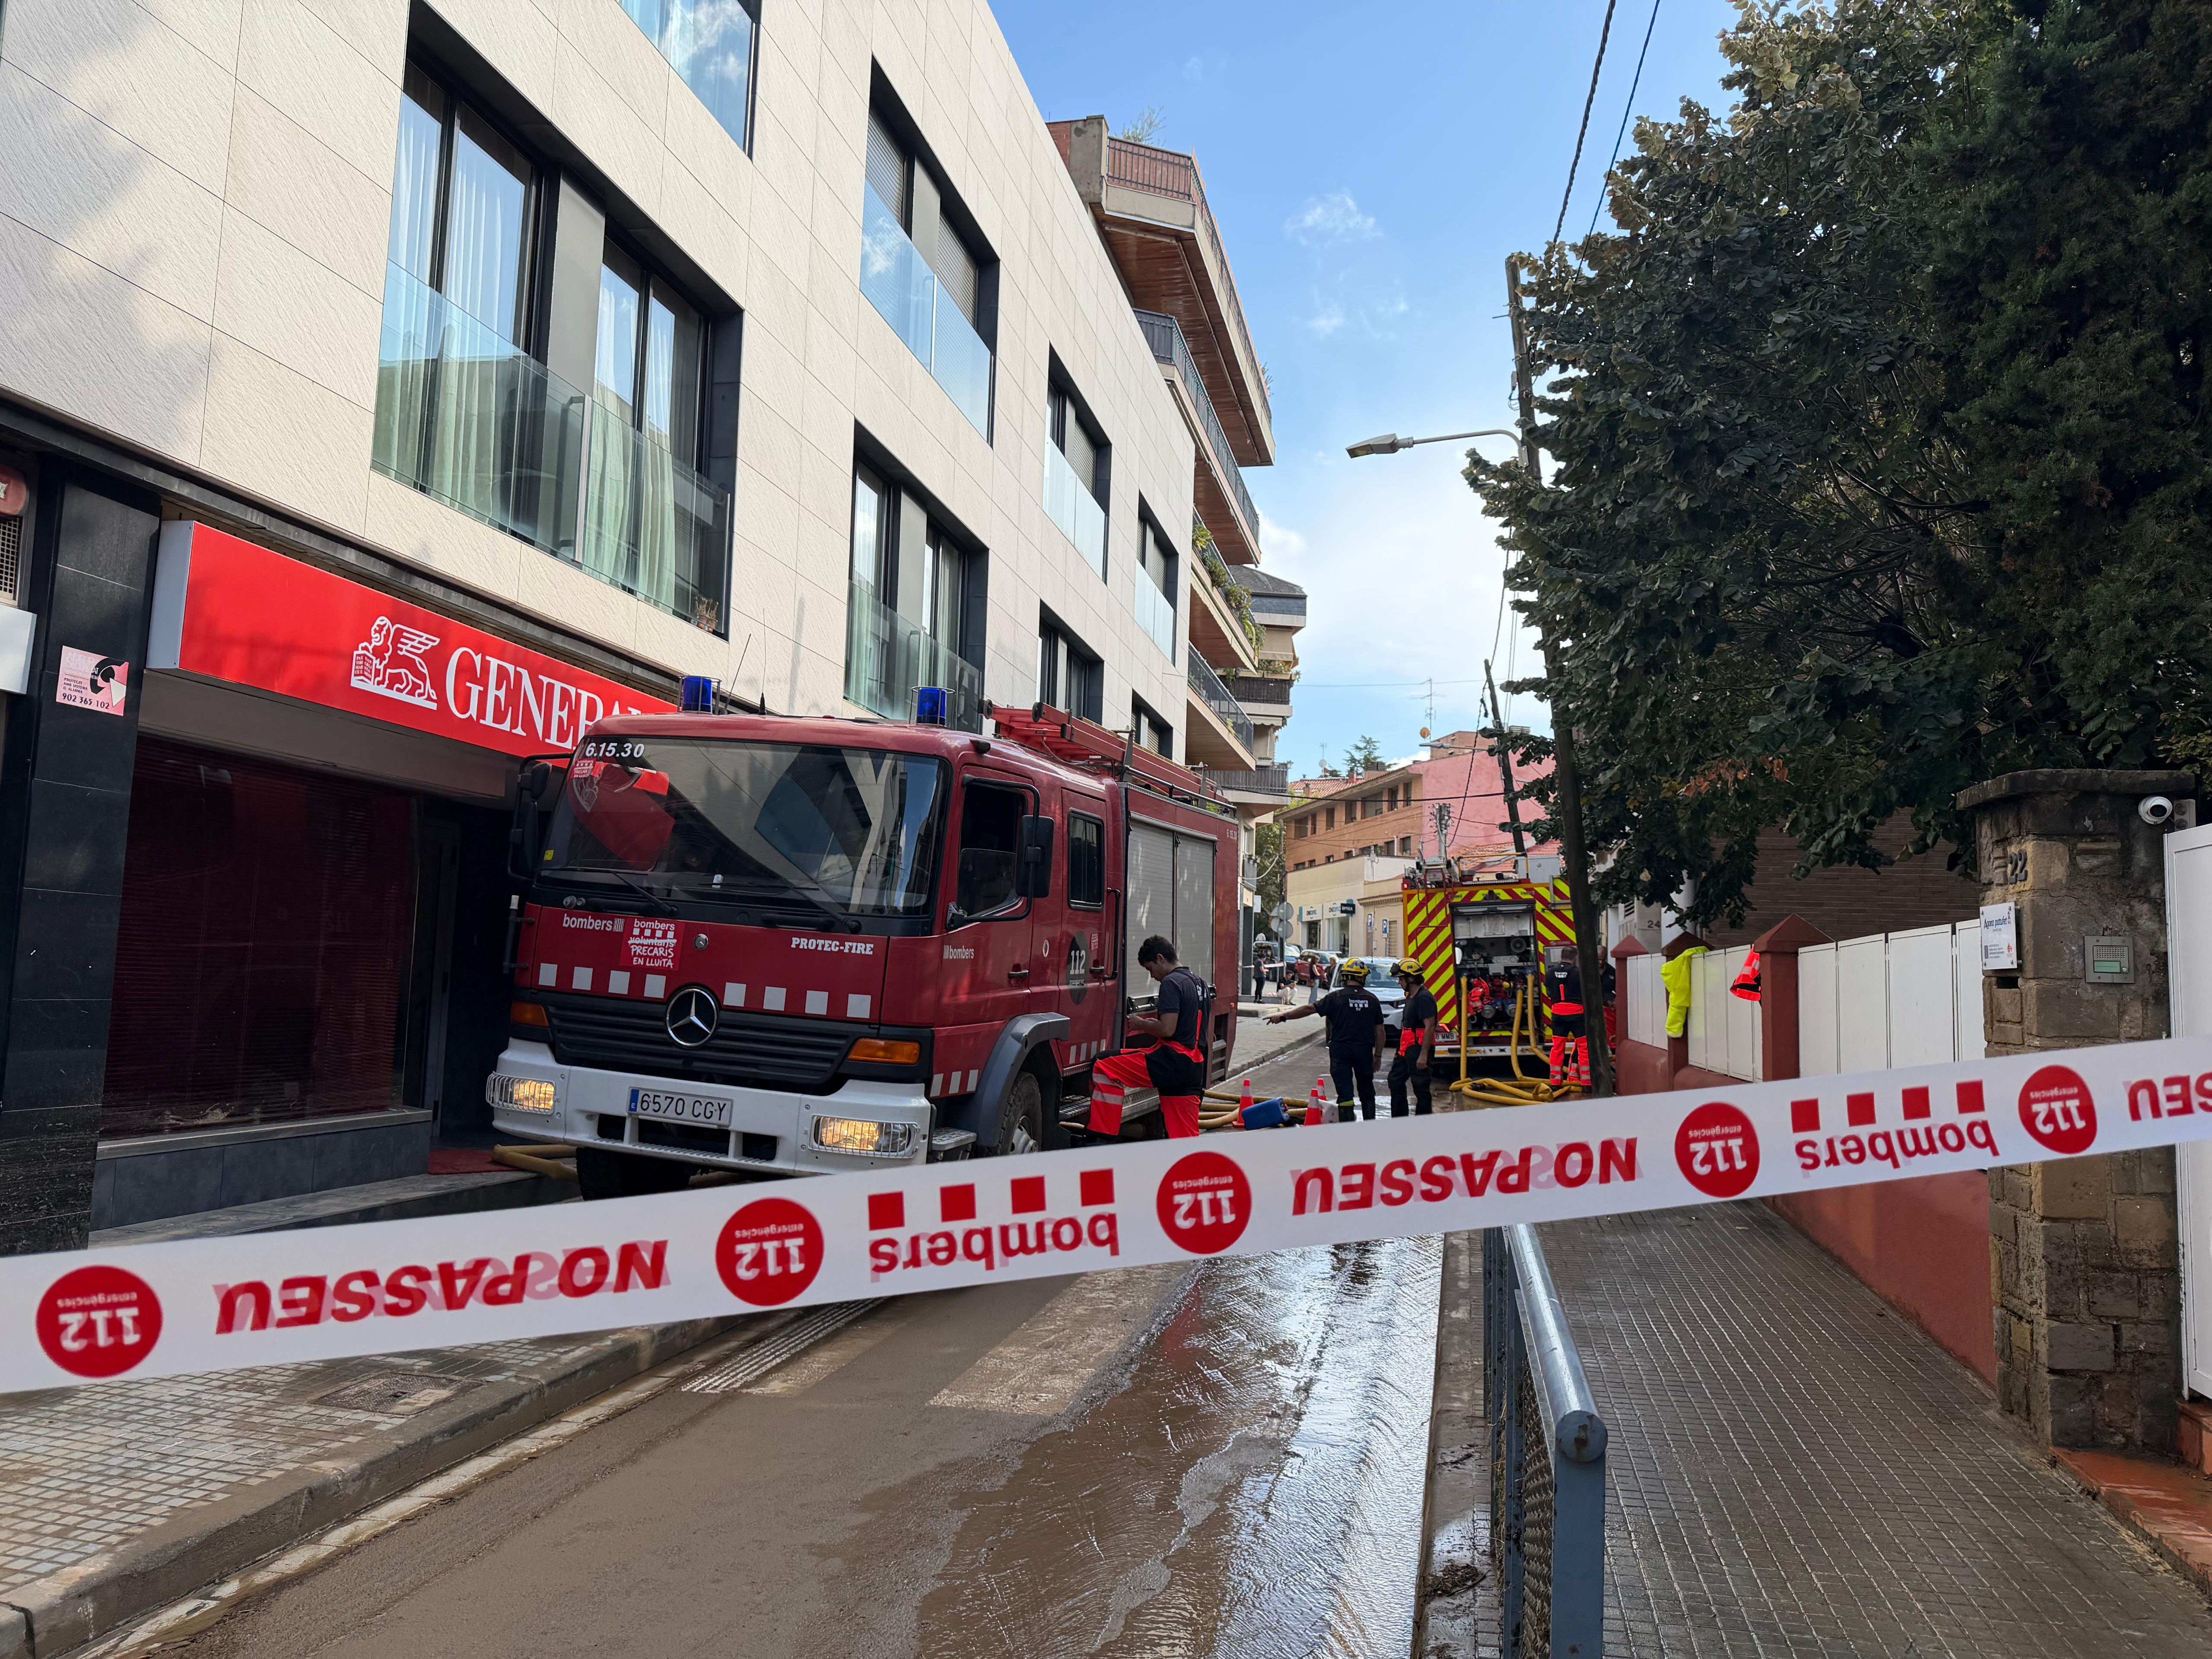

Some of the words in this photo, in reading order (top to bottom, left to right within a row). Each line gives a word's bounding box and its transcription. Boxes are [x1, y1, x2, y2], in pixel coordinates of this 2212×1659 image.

[62, 693, 77, 702] 902
[79, 696, 93, 706] 365
[96, 700, 110, 709] 102
[446, 646, 641, 750] GENER
[585, 742, 645, 758] 6.15.30
[2007, 849, 2028, 884] 22
[563, 913, 613, 931] bombers
[634, 918, 675, 930] bombers
[791, 937, 874, 955] PROTEC-FIRE
[949, 945, 974, 959] bombers
[633, 957, 644, 966] EN
[1070, 950, 1086, 975] 112
[640, 1093, 685, 1116] 6570
[692, 1100, 727, 1121] CGY
[2030, 1087, 2078, 1100] emergències
[2031, 1099, 2086, 1135] 112
[1688, 1125, 1742, 1139] emergències
[1795, 1120, 2000, 1170] bombers
[1554, 1137, 1637, 1188] NO
[1689, 1138, 1747, 1176] 112
[1173, 1175, 1233, 1190] emergències
[1292, 1150, 1532, 1216] PASSEU
[1173, 1189, 1236, 1230] 112
[734, 1223, 804, 1239] emergències
[869, 1212, 1119, 1273] bombers
[557, 1240, 668, 1298] NO
[735, 1237, 805, 1281] 112
[57, 1292, 137, 1309] emergències
[216, 1253, 532, 1334] PASSEU
[58, 1306, 141, 1352] 112
